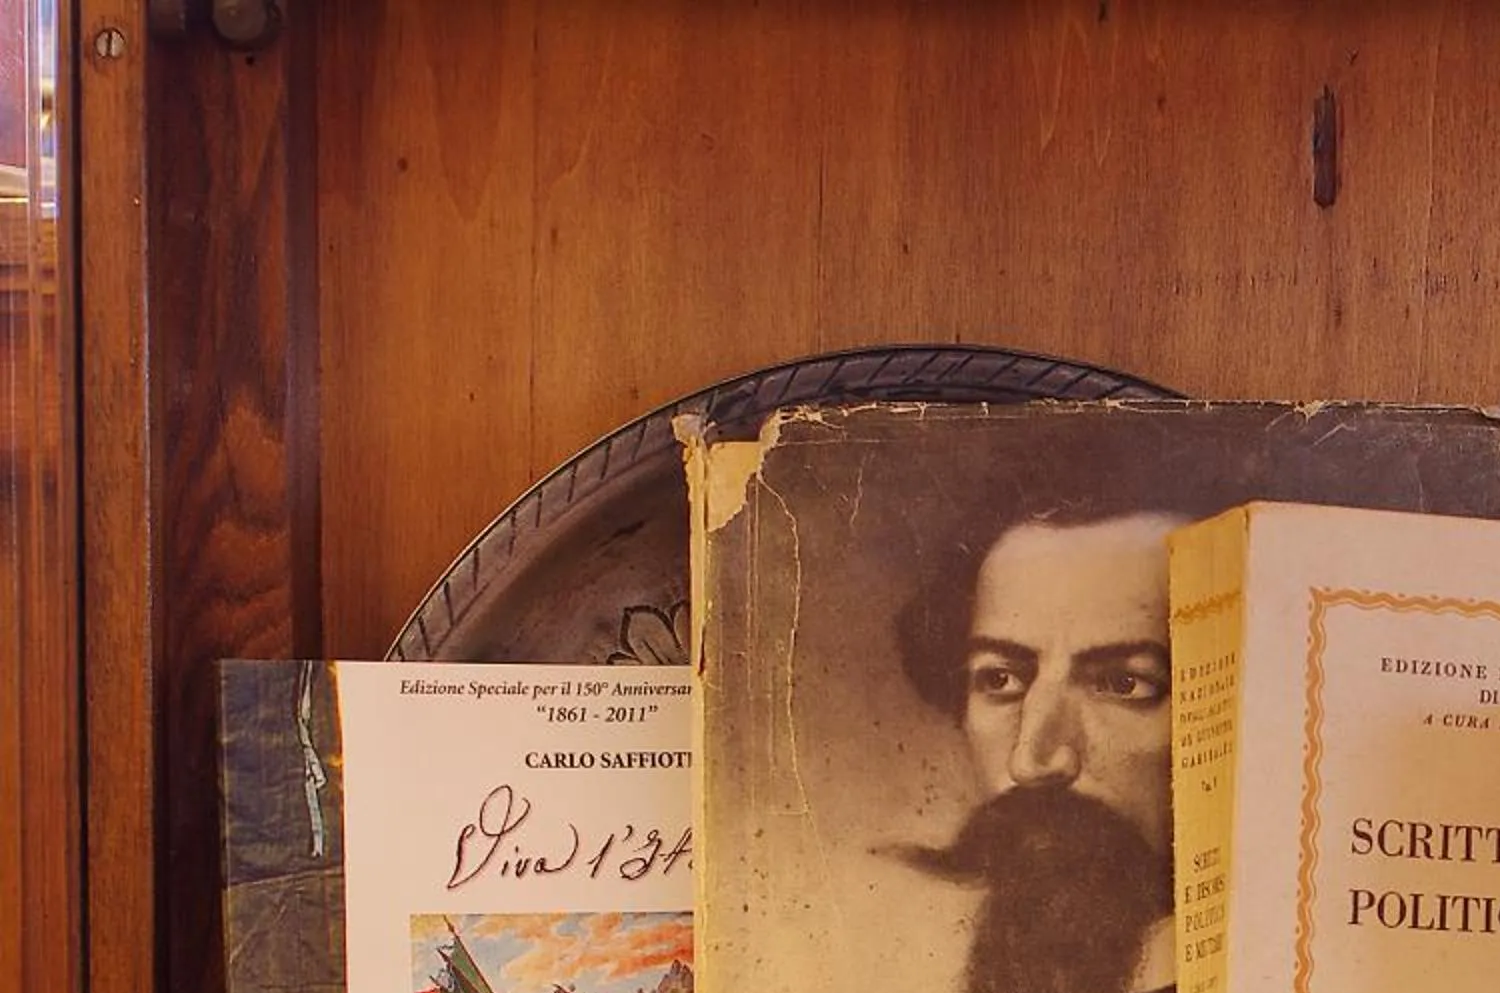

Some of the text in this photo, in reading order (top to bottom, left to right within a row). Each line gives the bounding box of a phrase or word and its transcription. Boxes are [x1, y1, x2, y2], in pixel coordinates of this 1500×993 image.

[1381, 657, 1488, 680] EDIZIONE
[400, 679, 465, 696] Edizione
[468, 680, 529, 699] Speciale
[533, 685, 557, 700] per
[561, 681, 571, 696] il
[577, 682, 609, 696] 150°
[1479, 689, 1499, 705] DI
[1422, 713, 1433, 726] A
[1443, 714, 1490, 730] CURA
[525, 752, 596, 769] CARLO
[446, 785, 579, 891] Viva
